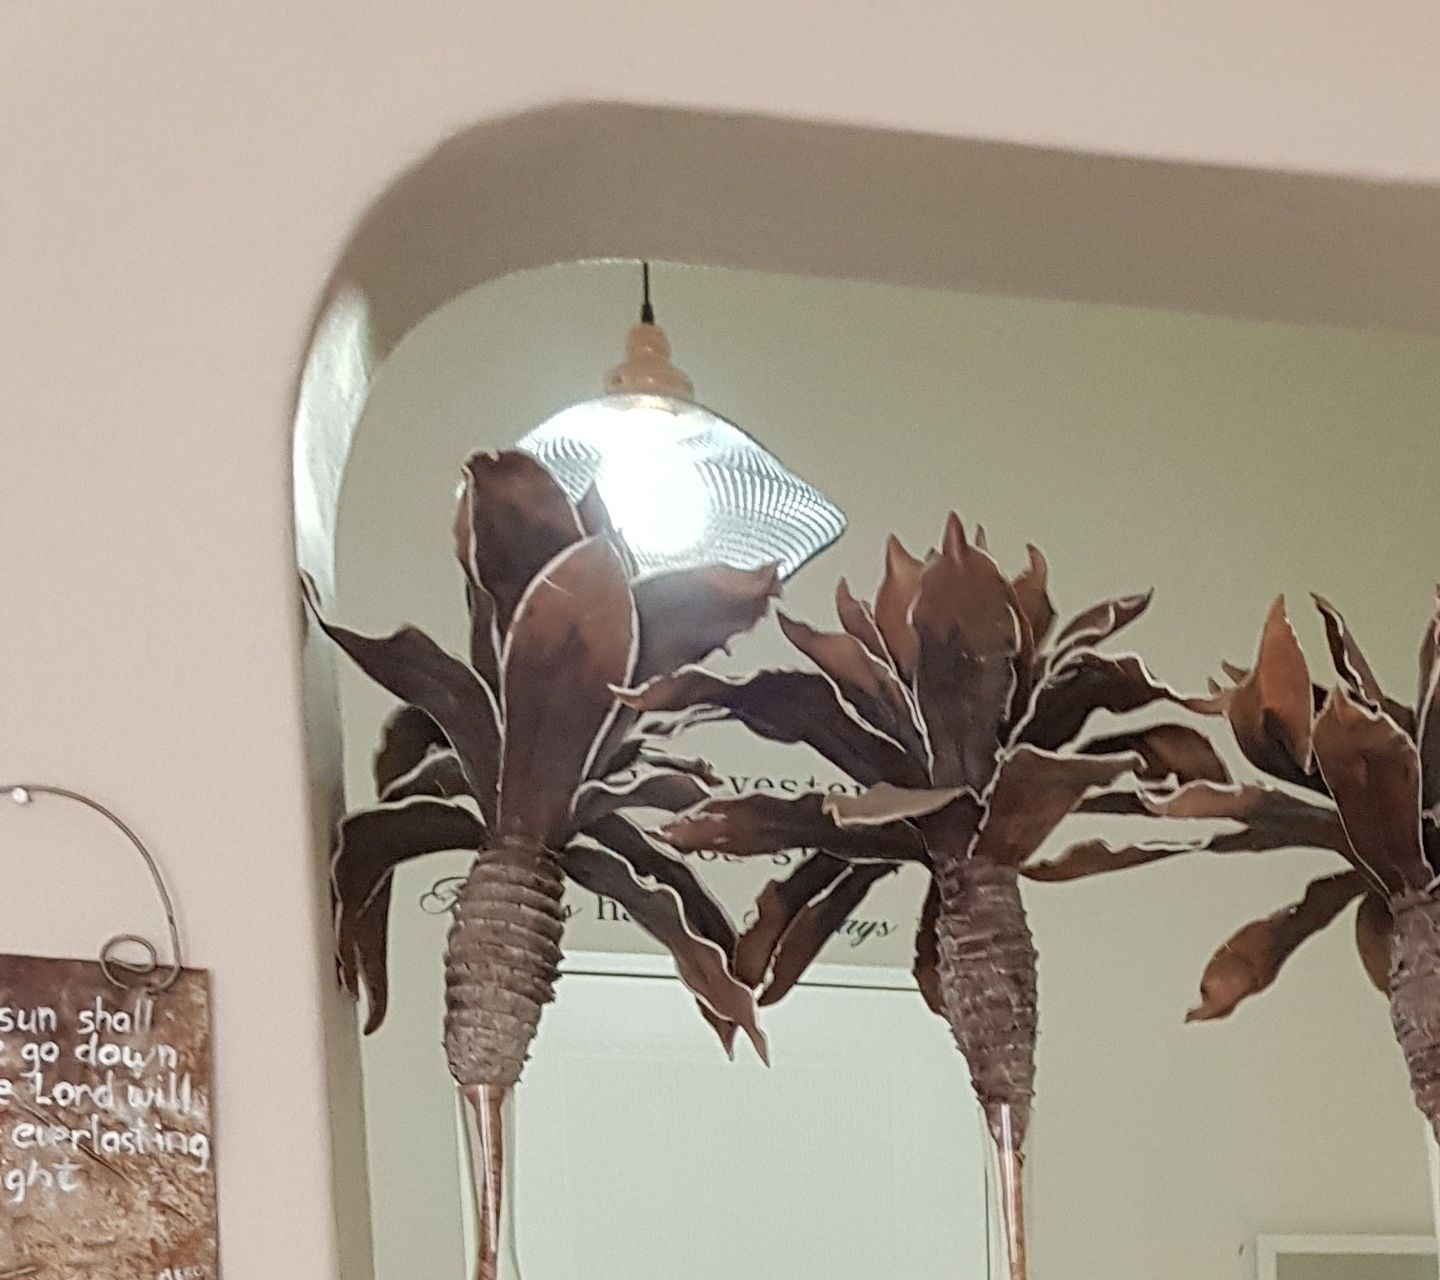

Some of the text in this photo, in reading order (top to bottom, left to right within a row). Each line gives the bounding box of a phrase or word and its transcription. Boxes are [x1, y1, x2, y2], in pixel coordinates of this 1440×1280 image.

[0, 996, 154, 1034] sun shall
[20, 1041, 60, 1077] go
[75, 1032, 178, 1070] down
[35, 1069, 115, 1109] Lord
[128, 1071, 192, 1114] will
[12, 1114, 210, 1173] everlasting
